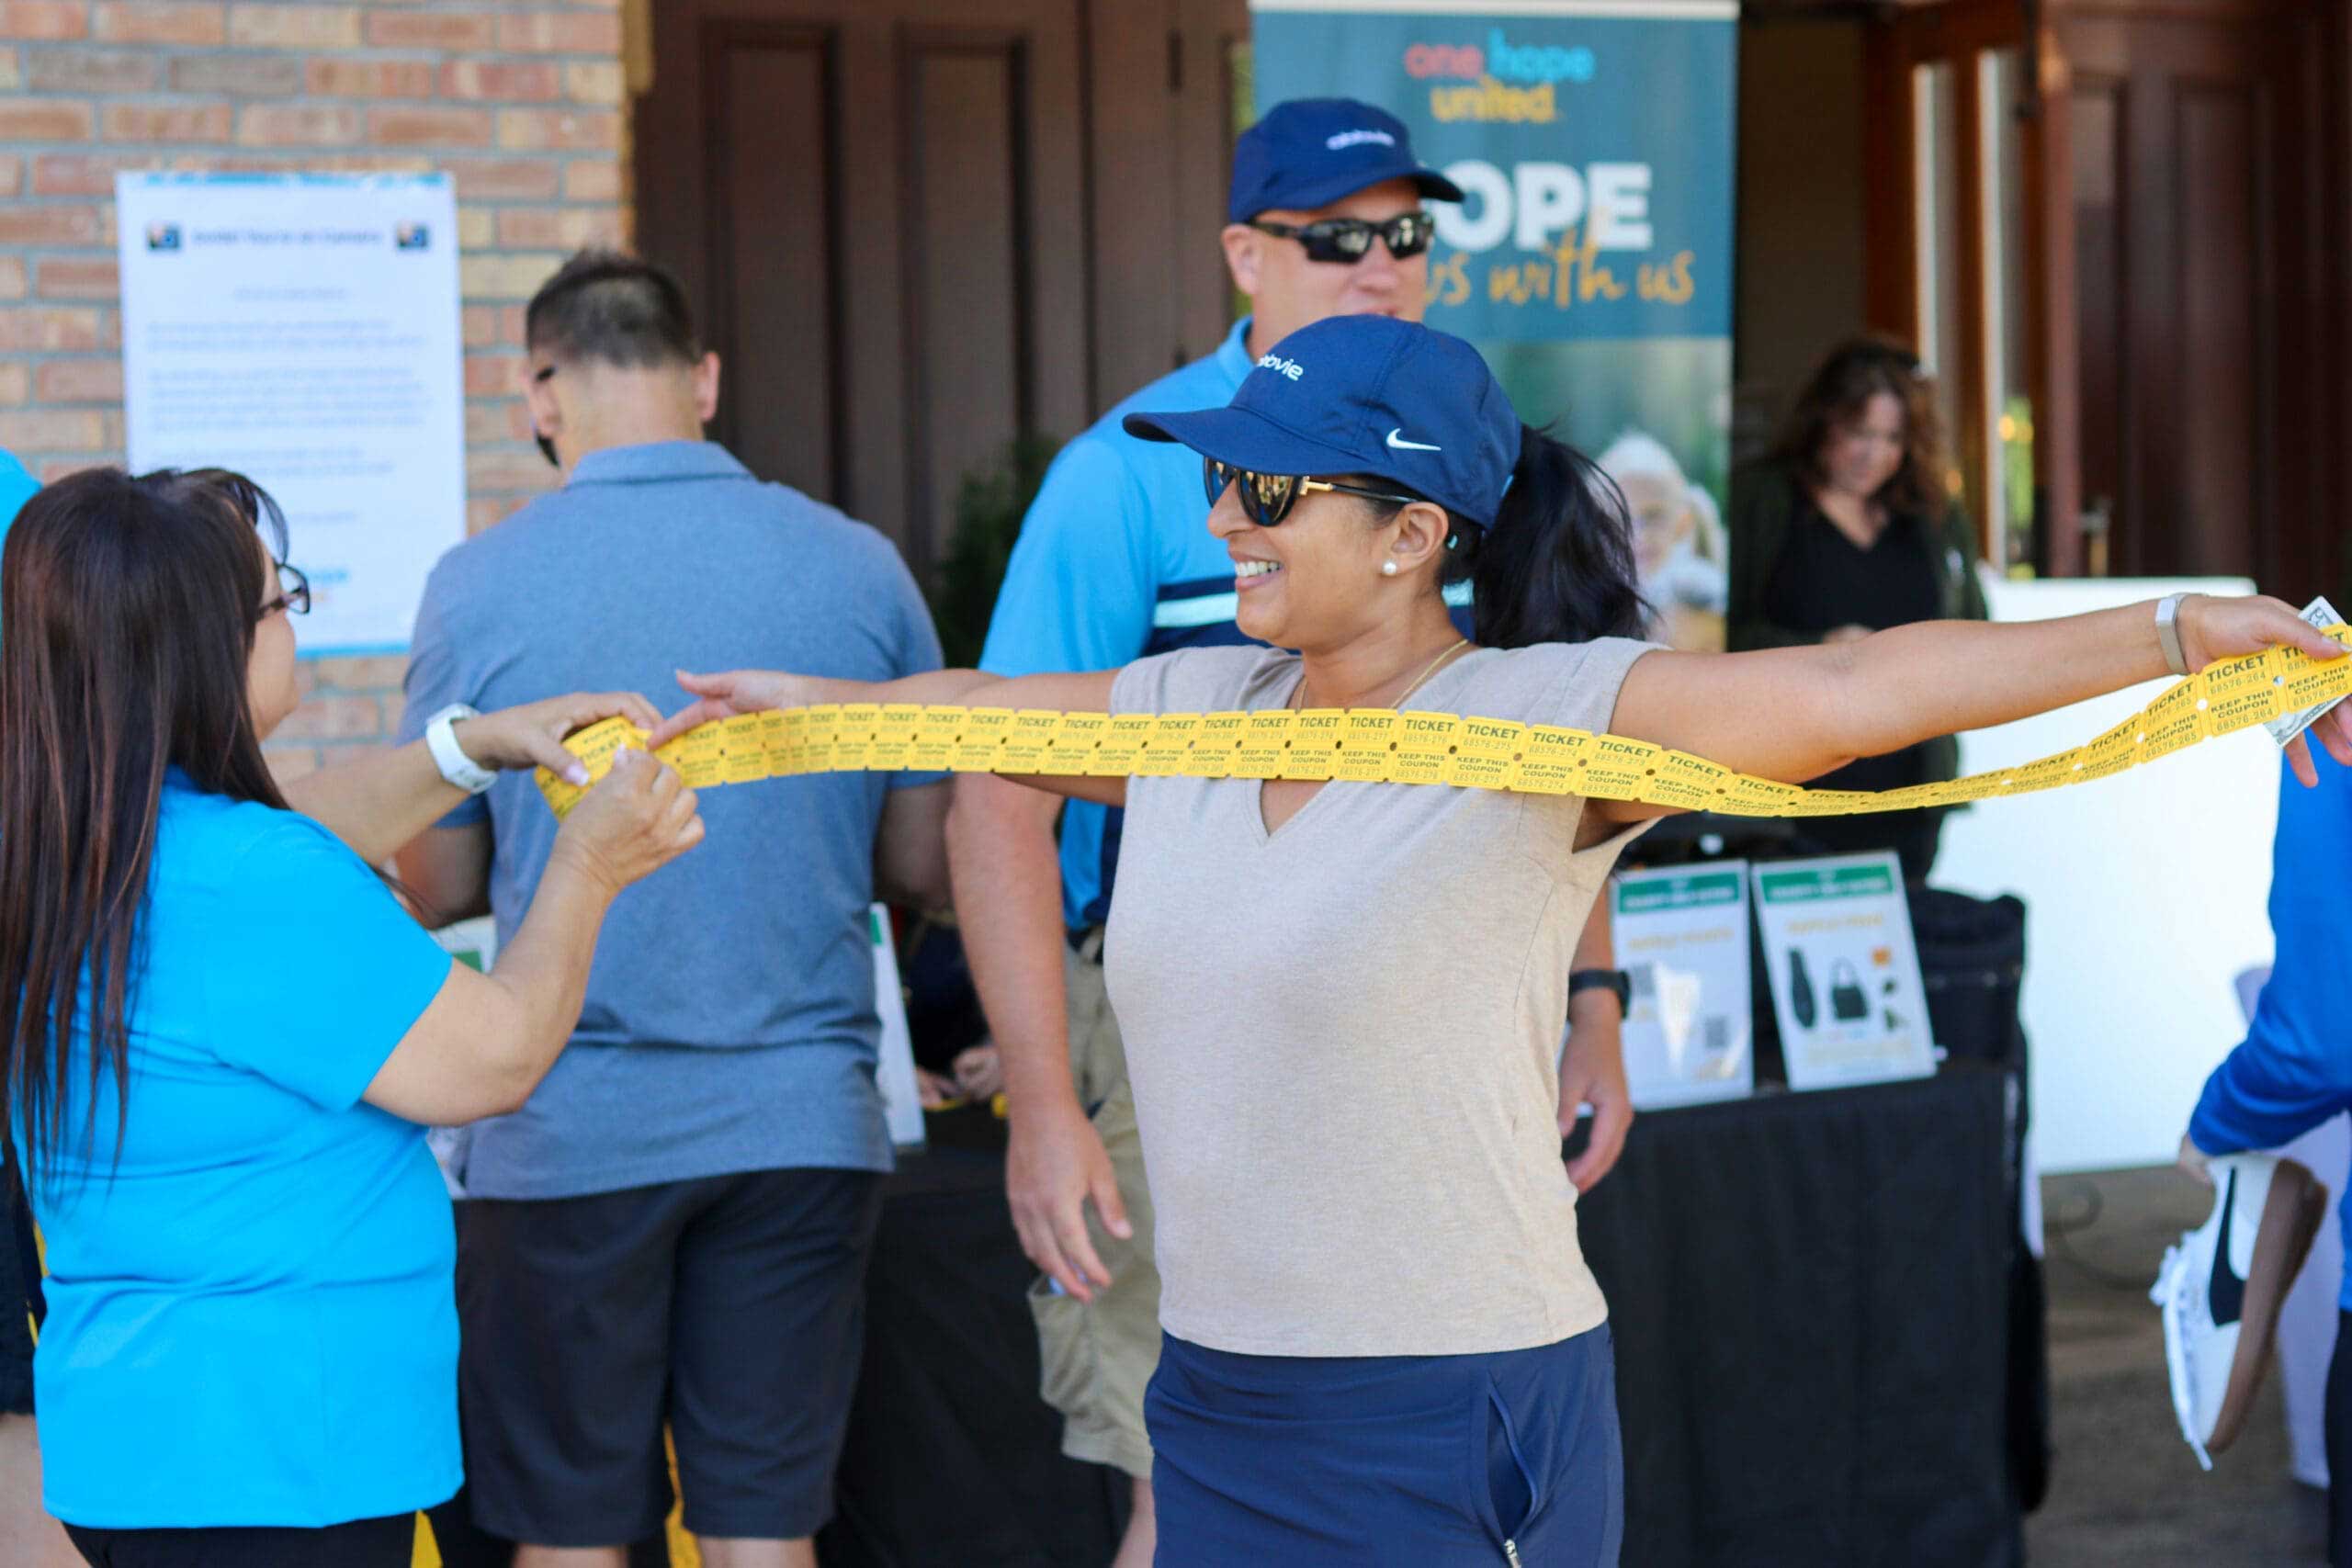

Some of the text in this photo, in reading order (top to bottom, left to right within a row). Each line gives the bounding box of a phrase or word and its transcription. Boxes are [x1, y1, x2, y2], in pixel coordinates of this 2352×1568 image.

[1404, 28, 1597, 84] one hope
[1418, 159, 1654, 252] OPE
[1489, 223, 1629, 310] with
[1635, 249, 1697, 304] us
[2206, 653, 2267, 683] TICKET
[2146, 681, 2195, 717] TICKET
[842, 711, 876, 722] TICKET
[883, 711, 918, 722] TICKET
[925, 712, 964, 724] TICKET
[970, 714, 1010, 726] TICKET
[1017, 716, 1057, 728] TICKET
[1064, 718, 1104, 729] TICKET
[1203, 718, 1244, 729] TICKET
[1250, 717, 1291, 728] TICKET
[1298, 716, 1340, 728] TICKET
[1350, 716, 1395, 729] TICKET
[1112, 719, 1151, 730] TICKET
[1158, 719, 1197, 730] TICKET
[1405, 718, 1456, 733] TICKET
[1465, 723, 1521, 741] TICKET
[2090, 718, 2139, 751] TICKET
[1532, 731, 1588, 748] TICKET
[1599, 740, 1657, 759] TICKET
[1668, 754, 1727, 779] TICKET
[1739, 778, 1797, 796] TICKET
